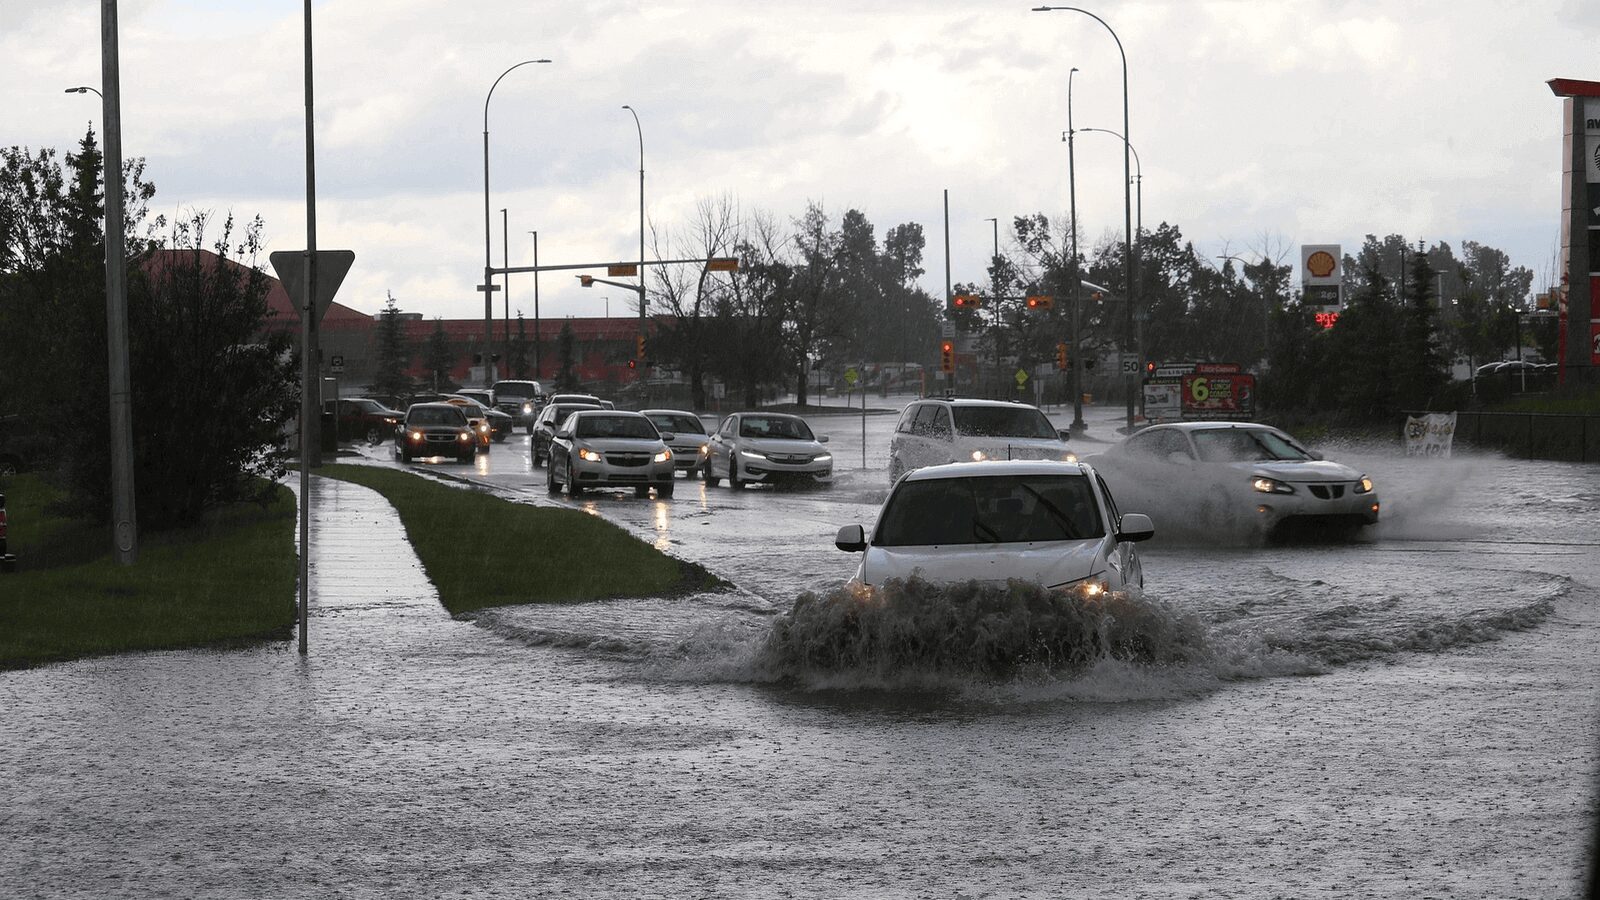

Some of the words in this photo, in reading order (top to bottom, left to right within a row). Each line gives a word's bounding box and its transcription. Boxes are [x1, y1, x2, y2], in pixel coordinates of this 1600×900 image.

[1123, 361, 1138, 372] 50
[1210, 383, 1231, 391] LUNCH
[1209, 390, 1232, 398] COMBO
